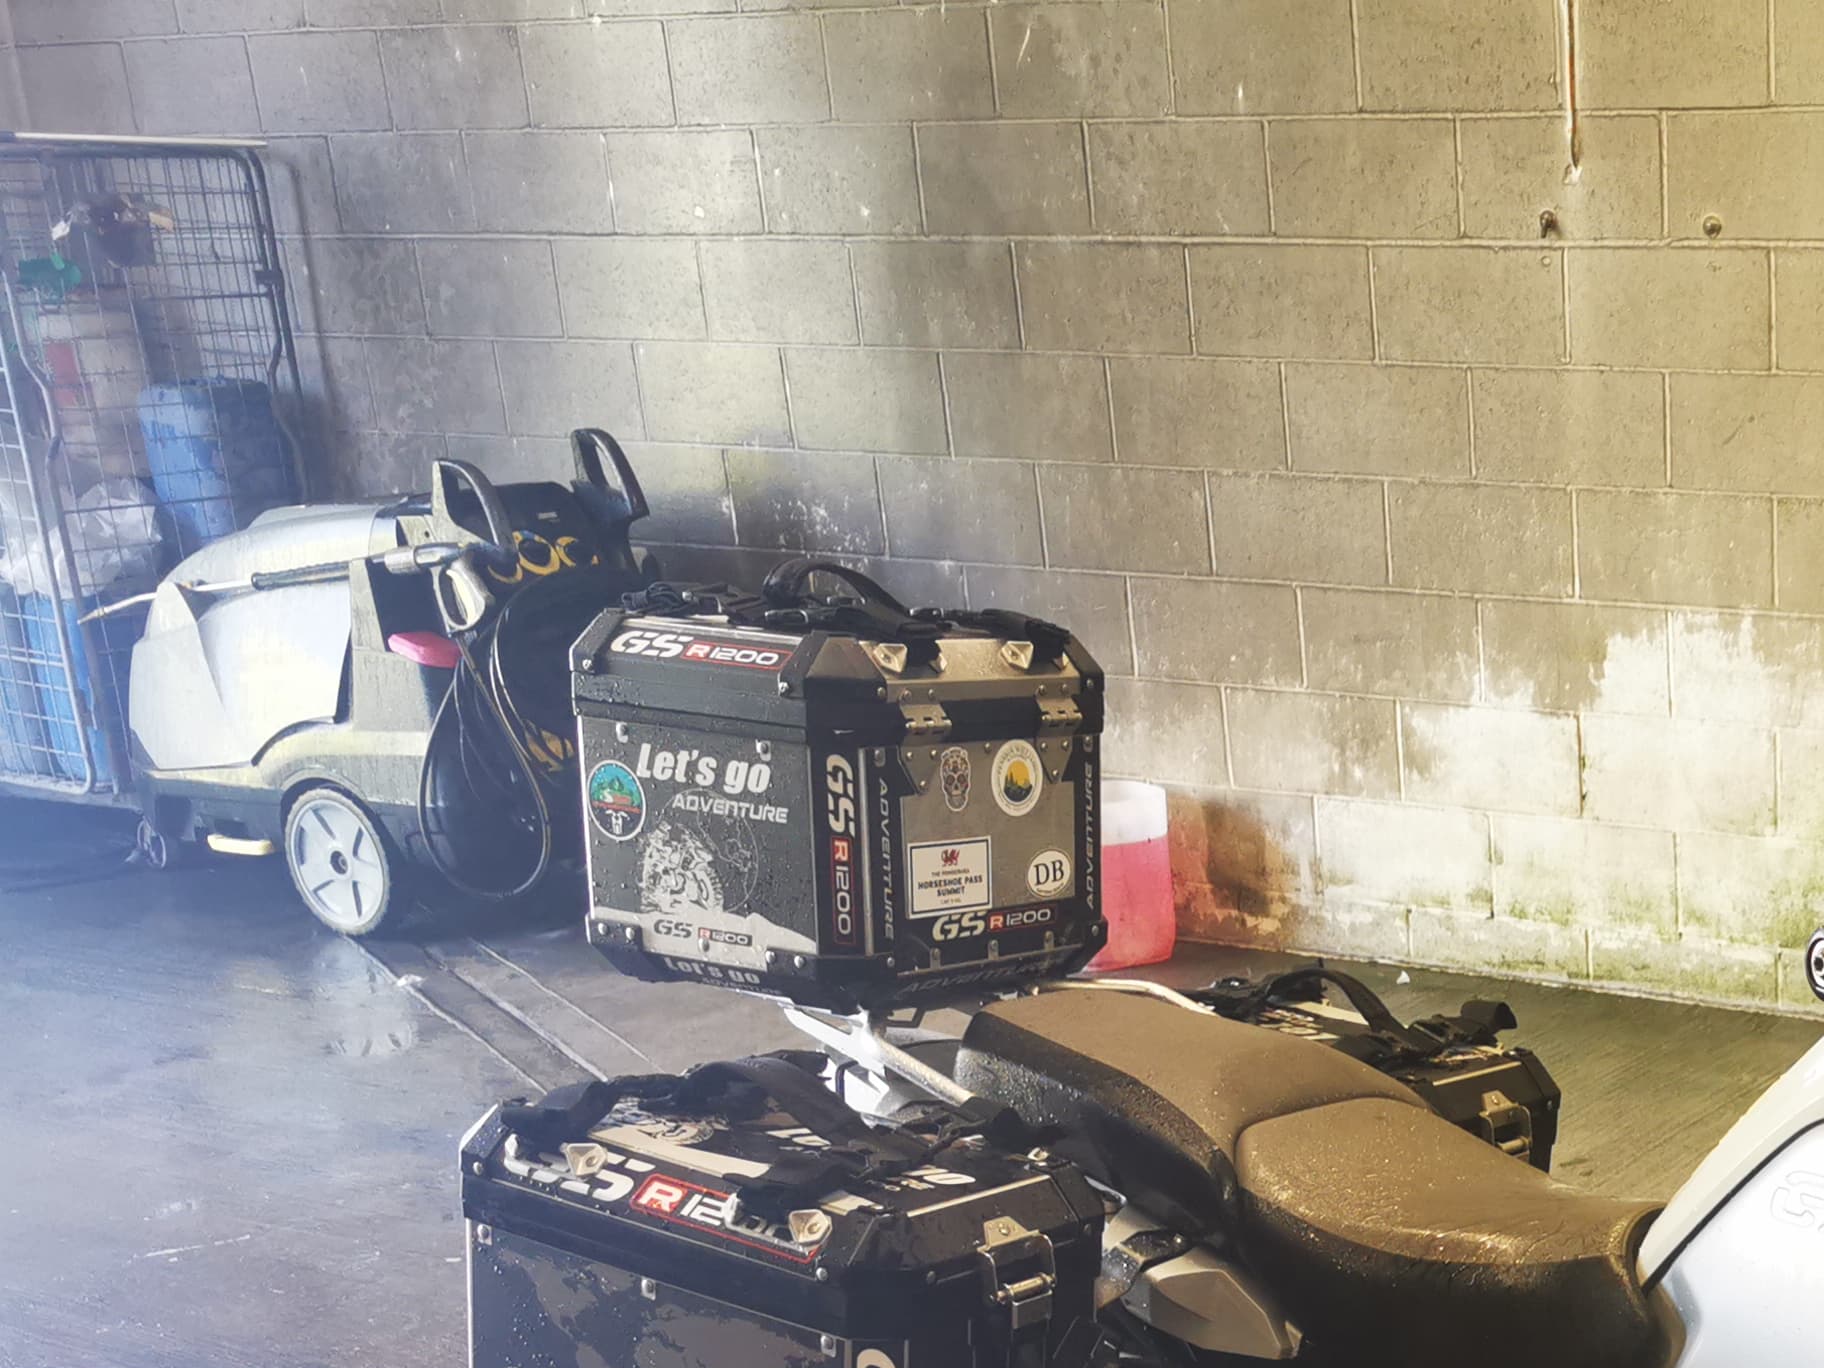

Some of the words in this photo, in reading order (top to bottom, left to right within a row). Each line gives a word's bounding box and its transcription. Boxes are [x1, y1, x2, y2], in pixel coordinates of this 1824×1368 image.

[611, 630, 693, 658] GS
[686, 644, 780, 666] R1200
[636, 742, 718, 787] Let's
[722, 759, 772, 795] go
[671, 794, 789, 824] ADVENTURE
[826, 753, 856, 840] GS
[879, 777, 895, 941] ADVENTURE
[1033, 860, 1065, 886] DB
[834, 839, 852, 936] R1200
[964, 875, 983, 885] PASS
[653, 918, 693, 939] GS
[932, 909, 988, 942] GS
[989, 908, 1052, 930] R1200
